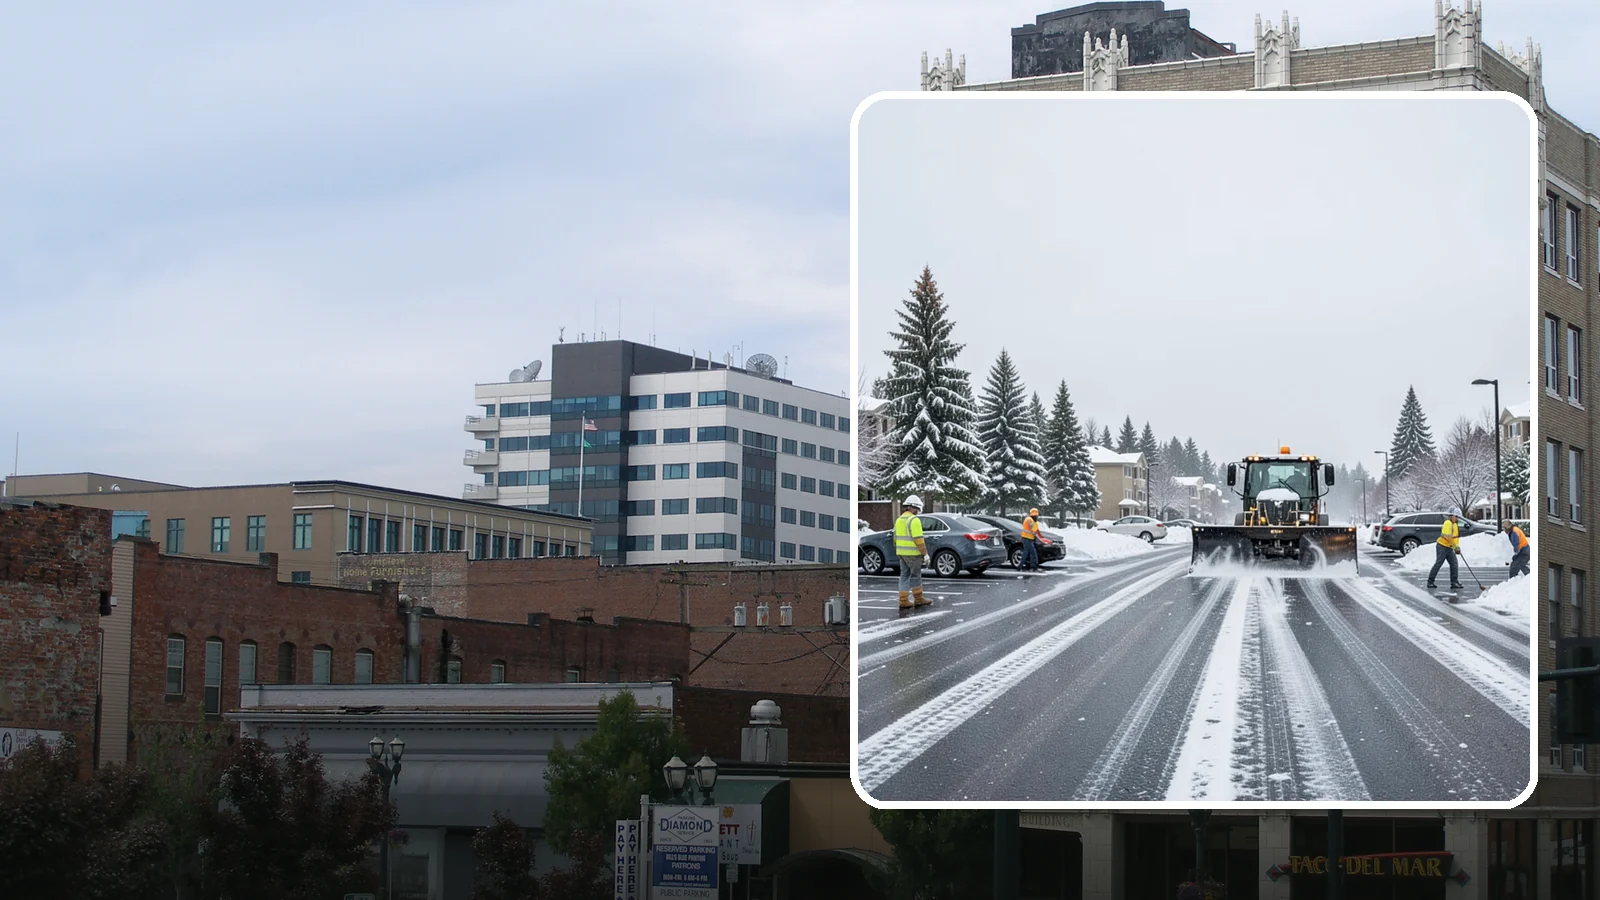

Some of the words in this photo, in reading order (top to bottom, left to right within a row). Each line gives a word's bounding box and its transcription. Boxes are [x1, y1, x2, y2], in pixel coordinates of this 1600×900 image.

[343, 567, 368, 577] Home
[660, 818, 713, 833] DIAMOND
[1022, 815, 1070, 828] BUILDING
[617, 825, 625, 852] PAY
[628, 824, 636, 852] PAY
[656, 845, 688, 853] RESERVED
[689, 846, 716, 854] PARKING
[627, 856, 636, 893] HERE
[1346, 856, 1385, 875] DEL
[1392, 857, 1442, 876] MAR
[616, 856, 625, 894] HERE
[660, 889, 682, 897] PUBLIC
[683, 889, 710, 898] PARKING
